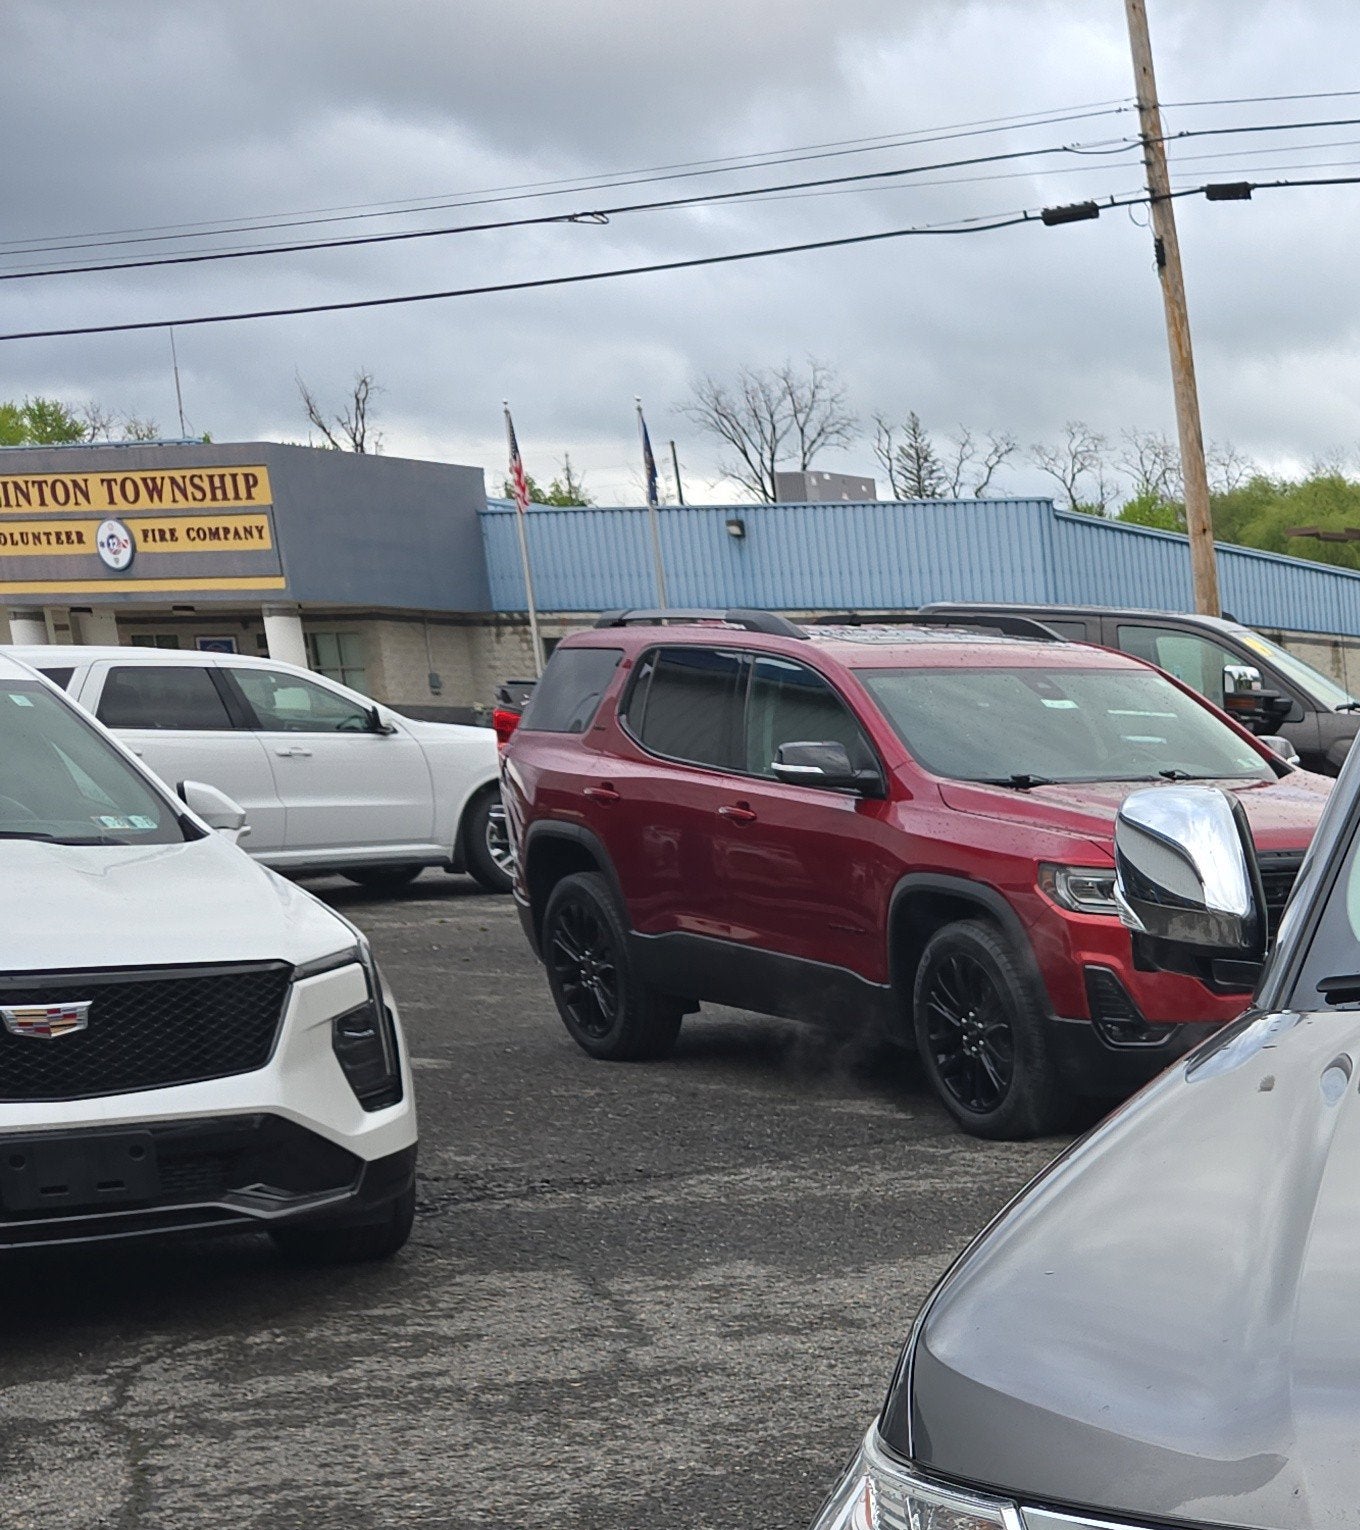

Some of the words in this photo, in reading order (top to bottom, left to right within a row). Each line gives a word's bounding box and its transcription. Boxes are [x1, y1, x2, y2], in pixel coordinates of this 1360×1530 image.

[0, 478, 91, 508] INTON
[100, 473, 259, 505] TOWNSHIP
[141, 528, 178, 543] FIRE
[186, 525, 264, 542] COMPANY
